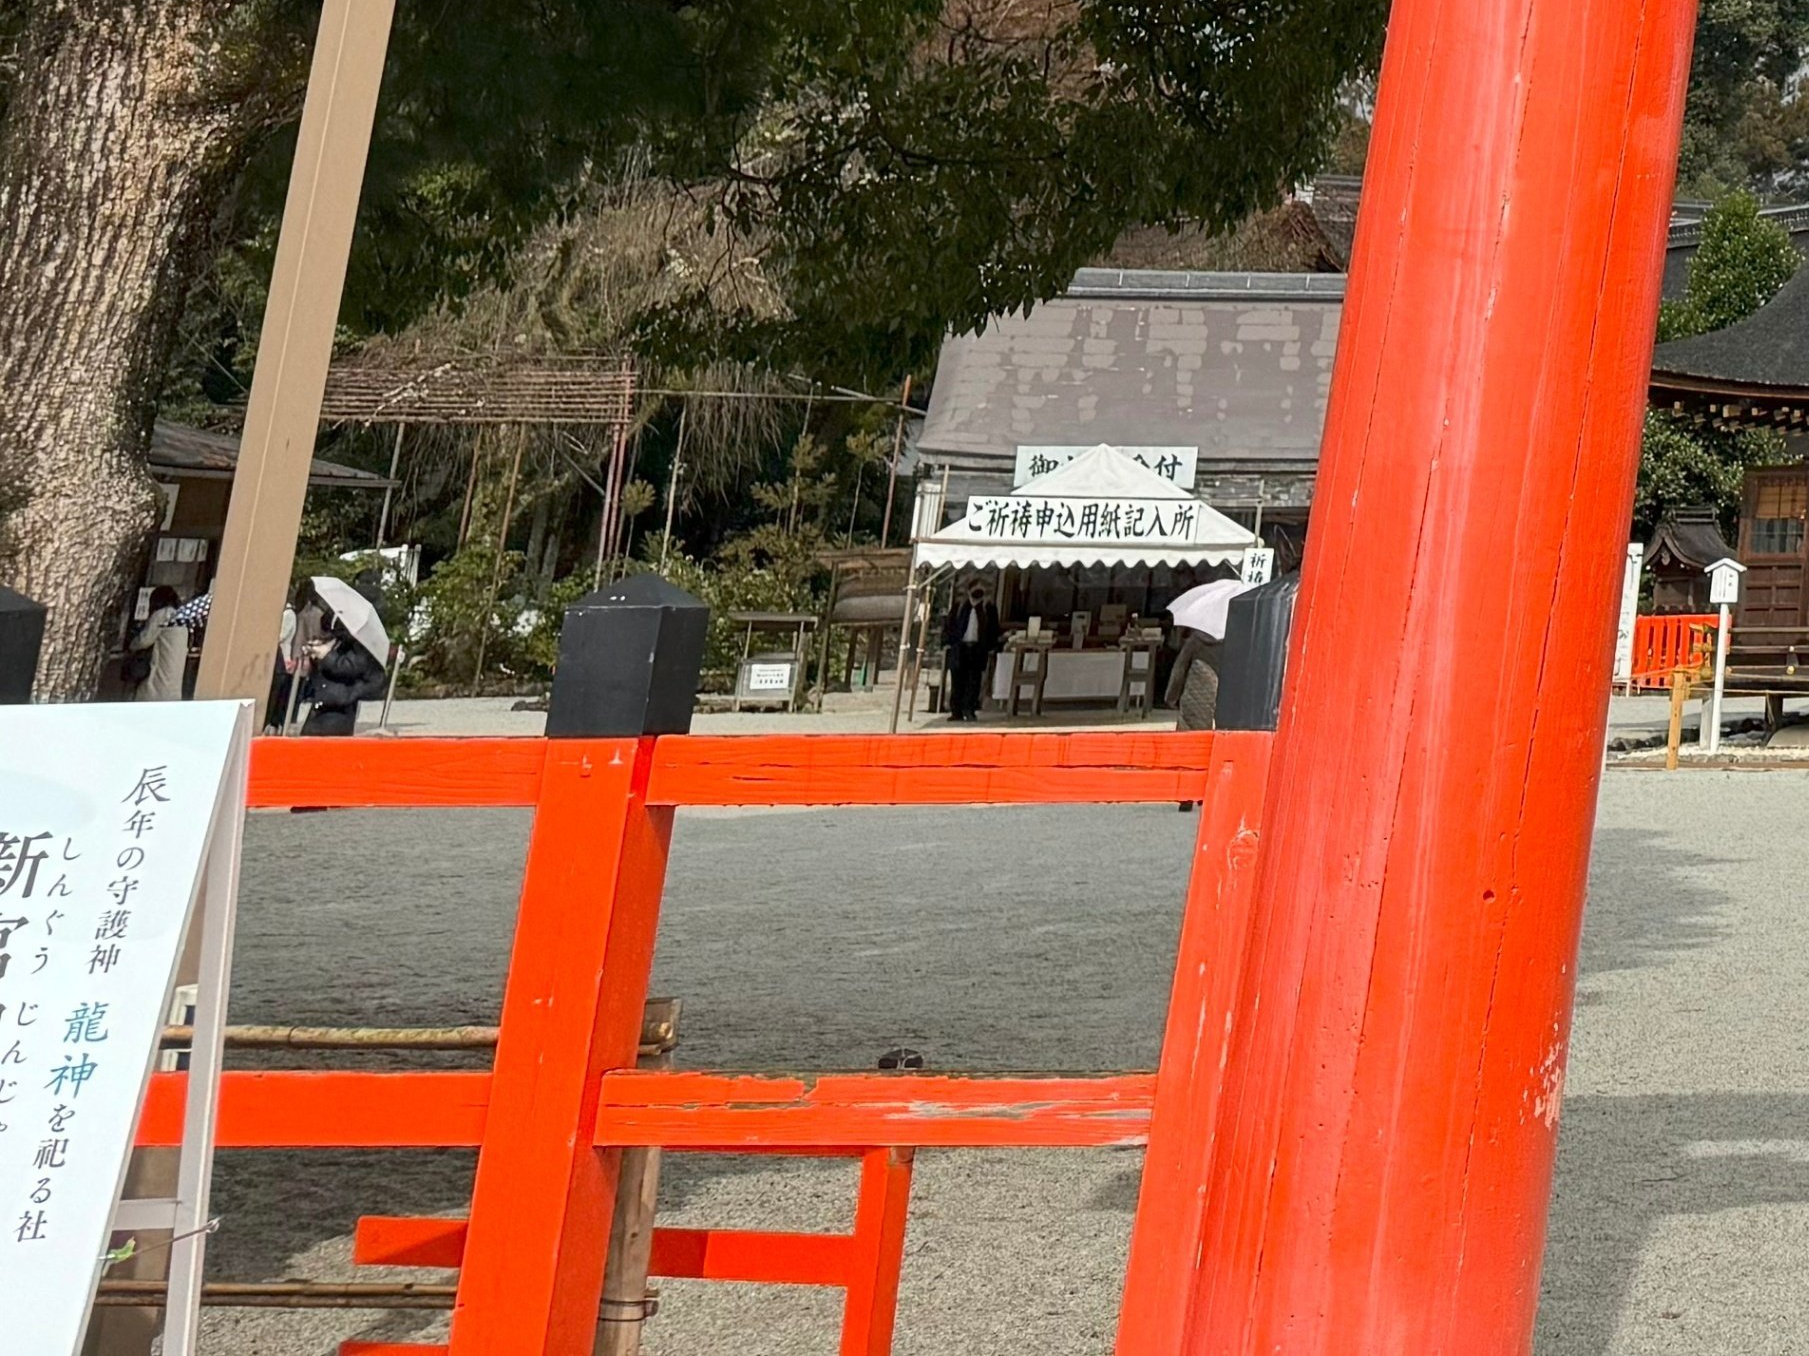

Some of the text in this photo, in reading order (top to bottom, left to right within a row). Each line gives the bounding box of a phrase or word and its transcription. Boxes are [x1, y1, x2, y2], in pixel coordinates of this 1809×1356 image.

[967, 499, 1195, 540] ご祈祷申込用紙記入所
[14, 765, 171, 1244] 辰年の守護神 龍神を祀る社
